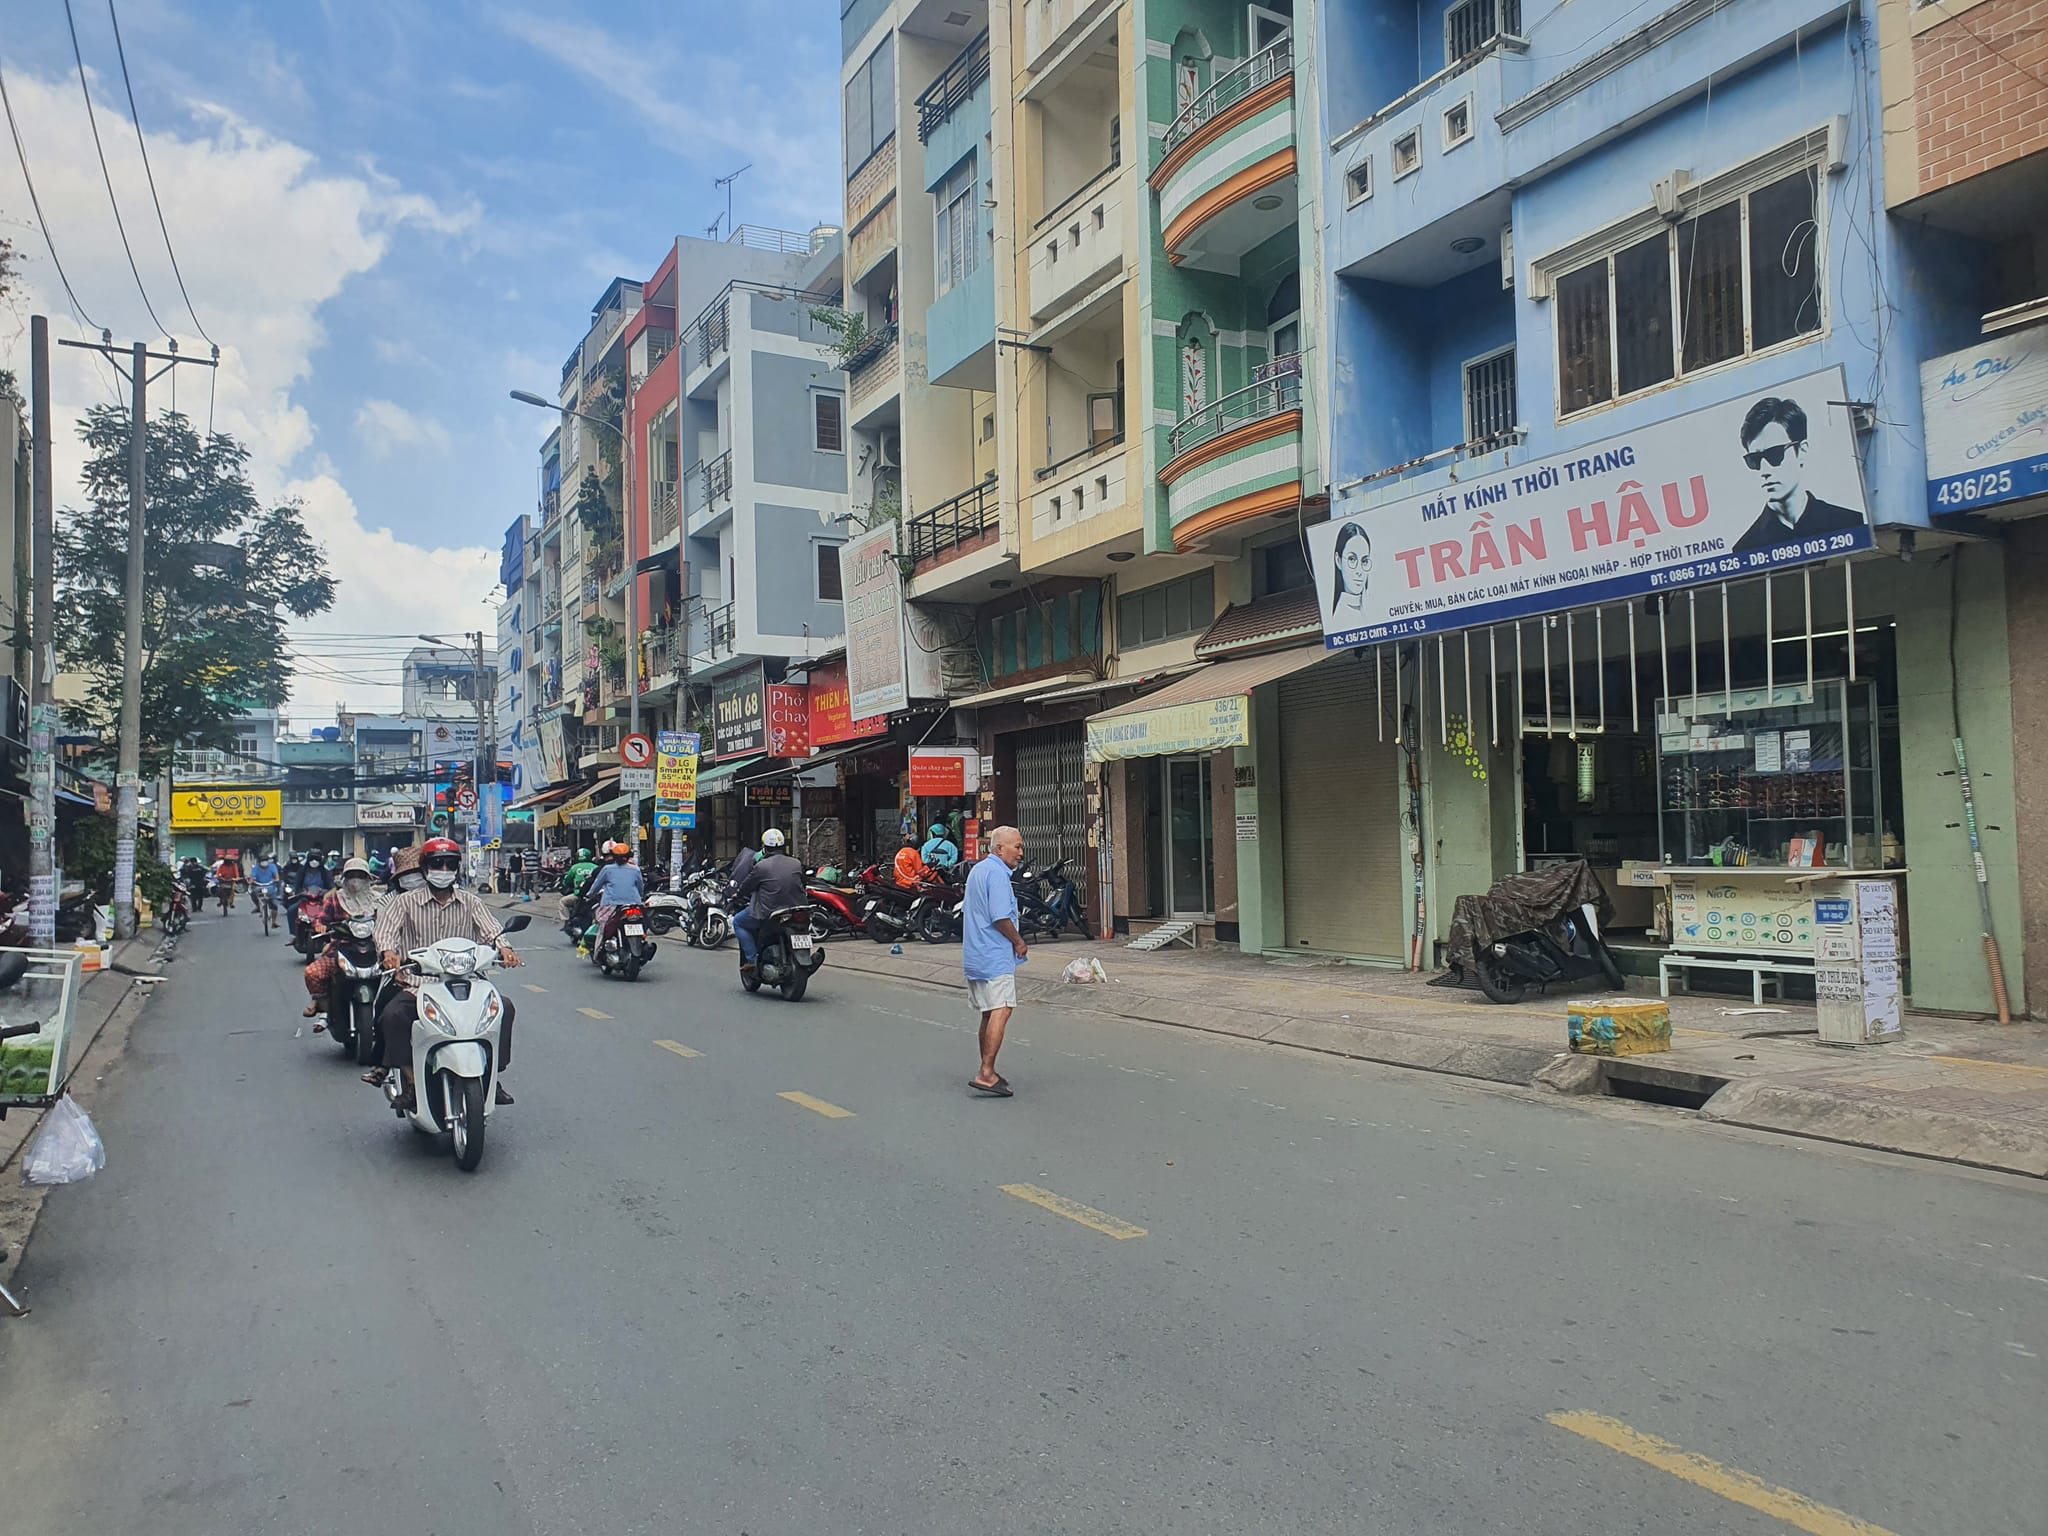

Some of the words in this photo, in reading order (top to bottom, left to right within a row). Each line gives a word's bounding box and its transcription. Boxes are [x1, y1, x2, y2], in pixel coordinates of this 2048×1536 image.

[1421, 492, 1457, 522] MẮT
[1464, 484, 1507, 511] KÍNH
[1512, 467, 1559, 497] THỜI
[1563, 446, 1636, 483] TRANG
[1936, 469, 2013, 505] 436/25
[1394, 511, 1548, 589] TRẦN
[1566, 474, 1711, 552] HẬU
[1650, 572, 1668, 587] ĐT:
[1669, 567, 1695, 583] 0866
[1697, 562, 1718, 577] 724
[1719, 557, 1741, 573] 626
[1771, 544, 1801, 562] 0989
[1803, 538, 1828, 555] 003
[1829, 532, 1855, 550] 290
[1389, 602, 1424, 618] CHUYÊN:
[1425, 597, 1447, 611] MUA,
[1447, 589, 1466, 606] BÁN
[1467, 586, 1486, 601] CÁC
[1487, 582, 1509, 598] LOẠI
[1510, 573, 1531, 593] MẮT
[1532, 570, 1558, 588] KÍNH
[1558, 564, 1590, 583] NGOẠI
[1591, 559, 1620, 577] NHẬP
[1629, 554, 1653, 570] HỢP
[1654, 545, 1683, 563] THỜI
[1684, 536, 1725, 557] TRANG
[1345, 630, 1368, 642] 436/23
[1368, 626, 1388, 639] CMT8
[1392, 623, 1409, 635] P.11
[1413, 619, 1426, 632] Q.3
[718, 692, 743, 724] THÁI
[744, 691, 759, 717] 68
[772, 689, 805, 707] Phở
[1215, 698, 1238, 713] 436/21
[772, 708, 810, 727] Chay
[659, 766, 683, 774] Smart
[684, 767, 695, 775] TV
[678, 759, 690, 767] LG
[661, 789, 669, 798] 6
[1633, 873, 1654, 881] HOYA
[1674, 893, 1696, 901] HOYA
